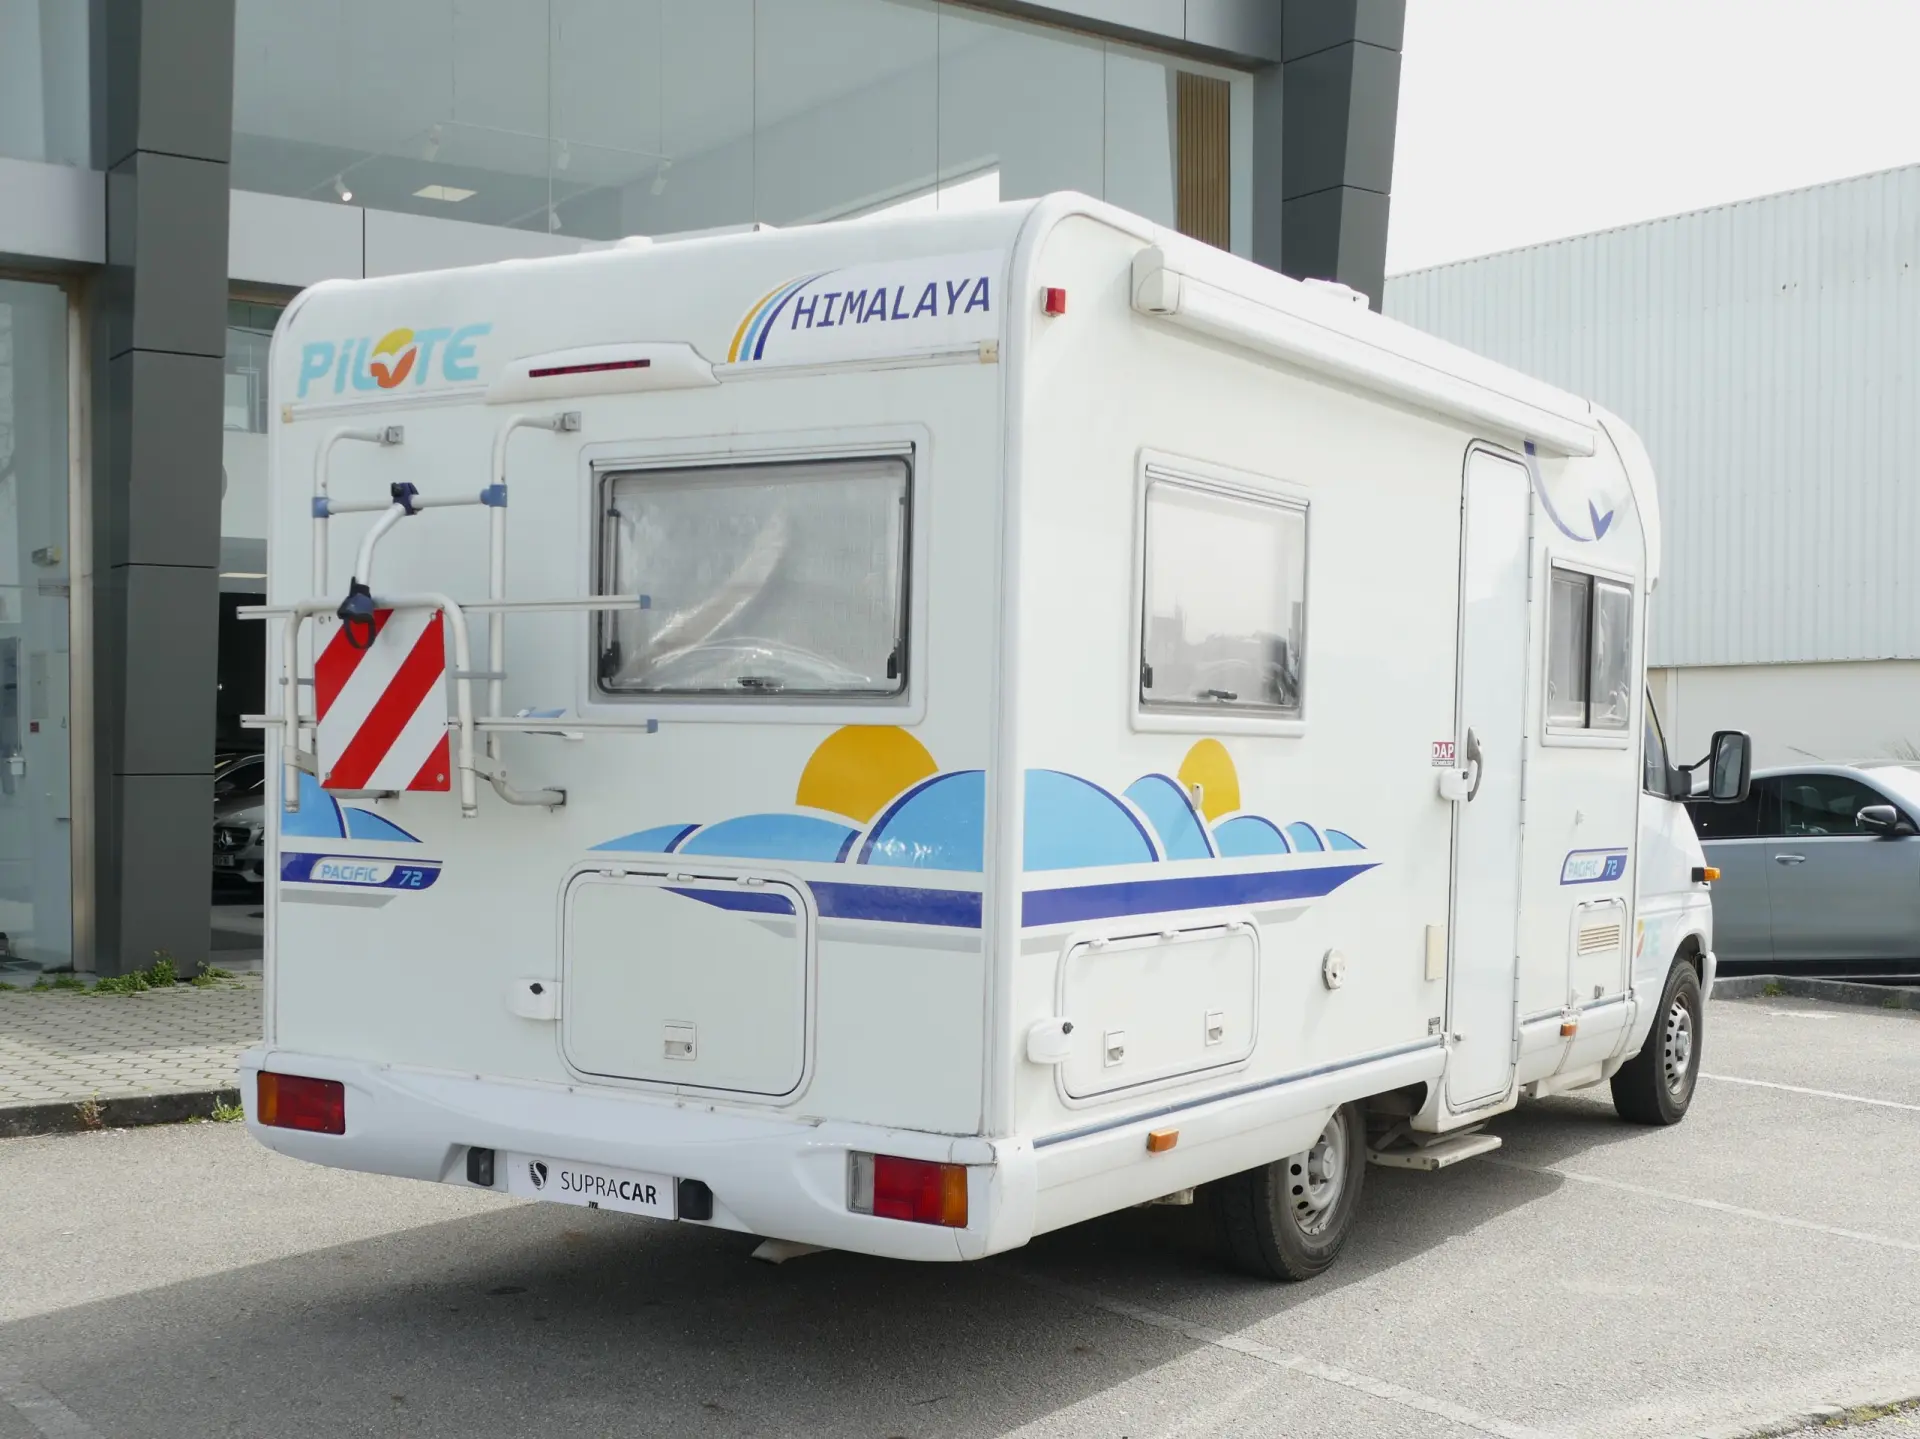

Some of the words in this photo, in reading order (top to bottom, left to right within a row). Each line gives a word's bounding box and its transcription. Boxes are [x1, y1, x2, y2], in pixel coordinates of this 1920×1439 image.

[791, 276, 990, 331] HIMALAYA
[1432, 742, 1455, 758] DAP
[1605, 859, 1618, 877] 72
[399, 869, 423, 887] 72
[560, 1171, 657, 1205] SUPRACAR
